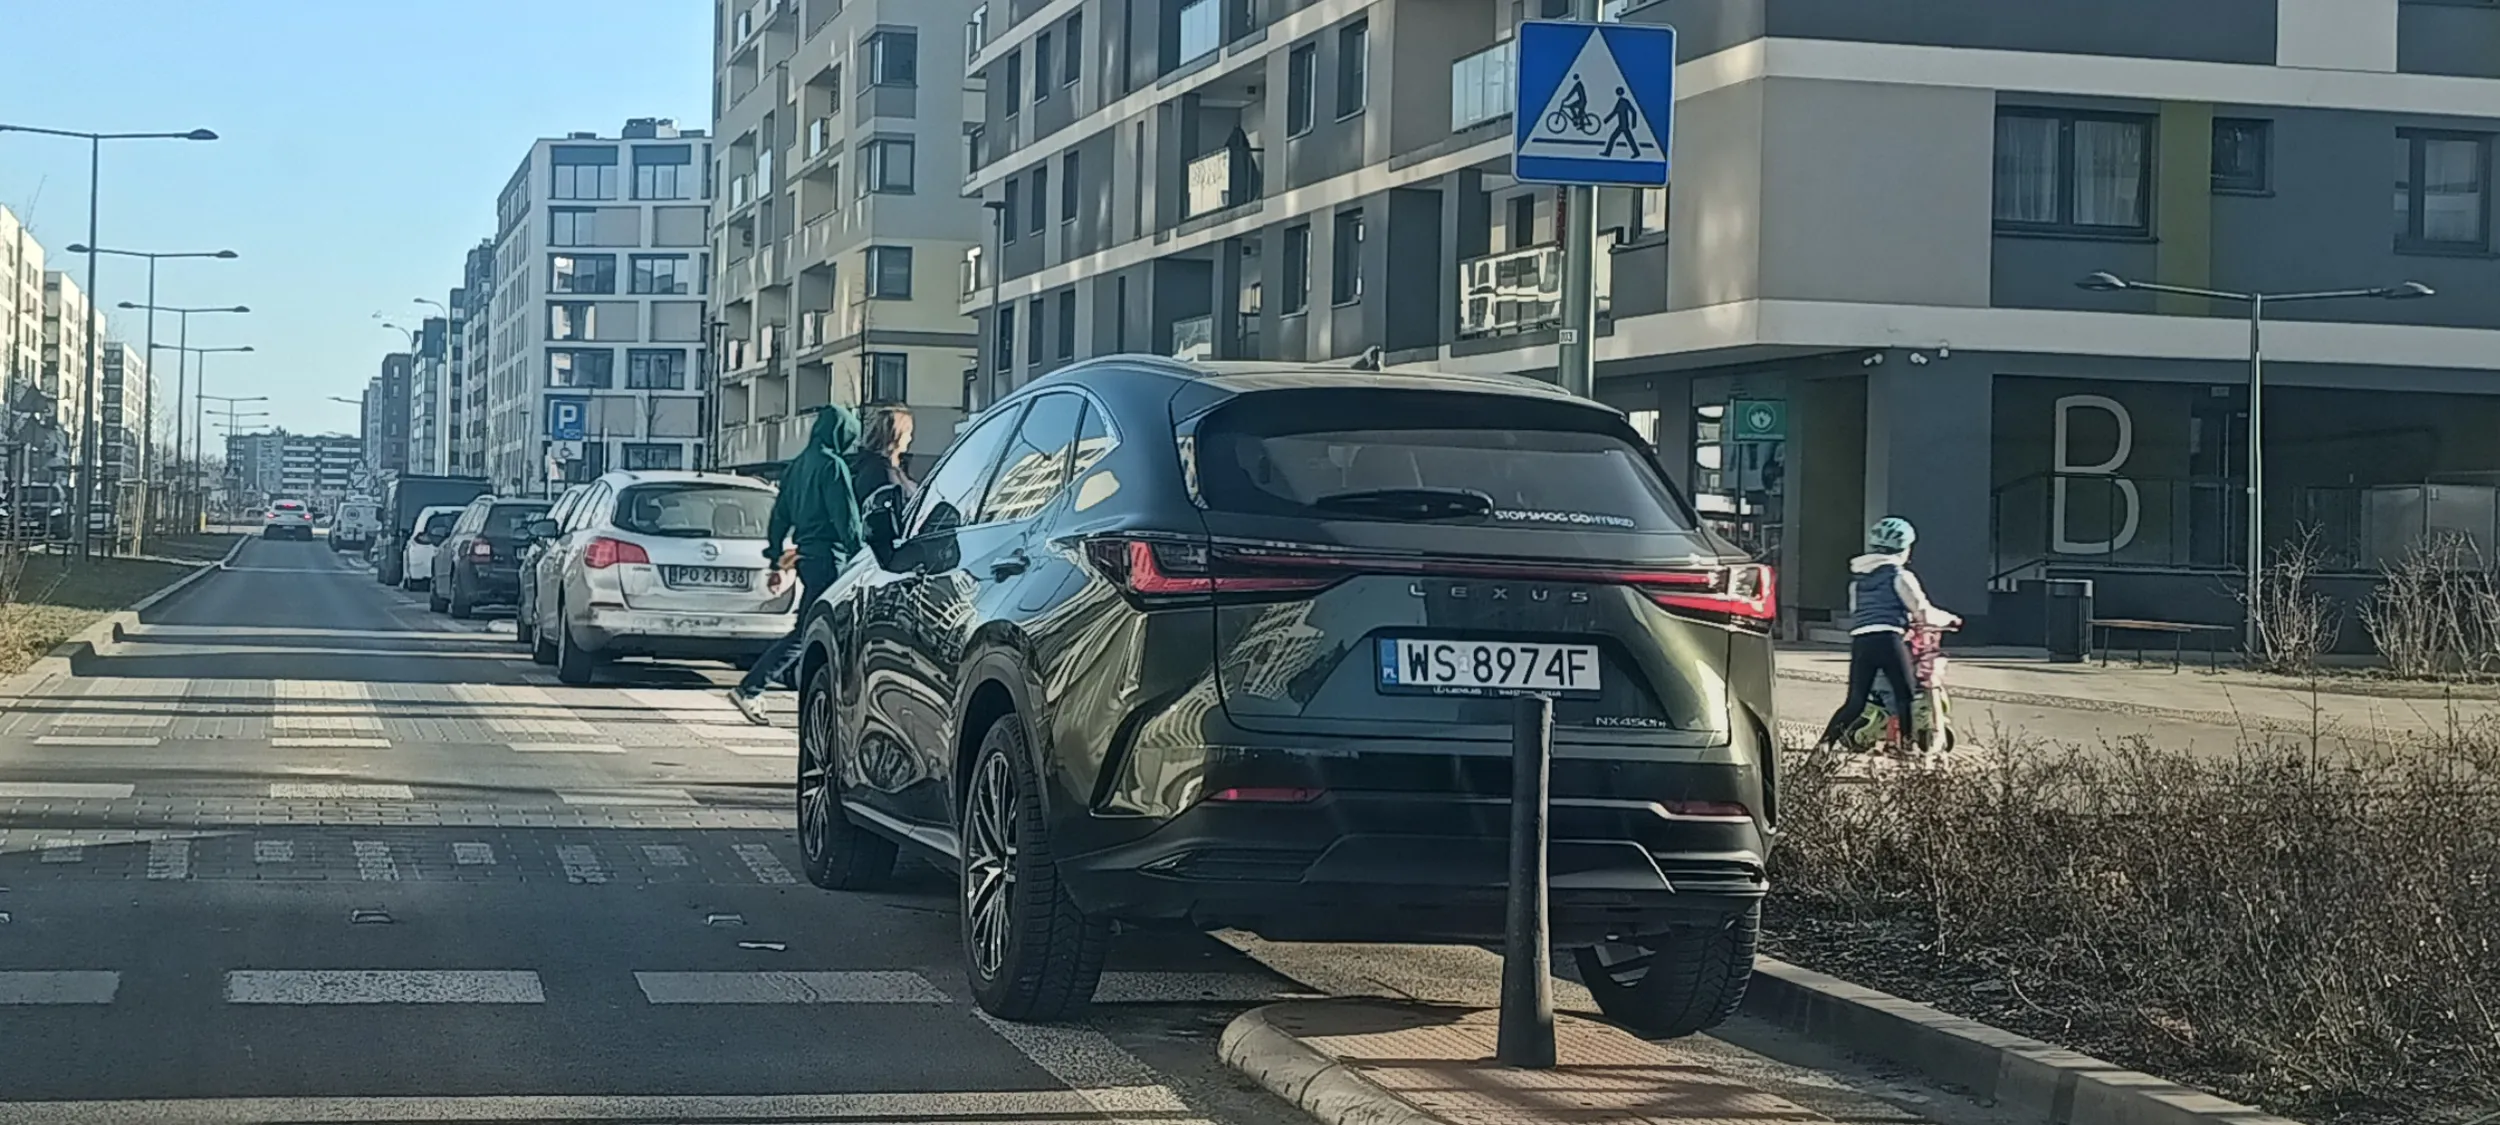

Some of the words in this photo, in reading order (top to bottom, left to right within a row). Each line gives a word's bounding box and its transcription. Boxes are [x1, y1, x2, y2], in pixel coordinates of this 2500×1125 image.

[558, 405, 577, 429] P
[2053, 394, 2140, 554] B
[679, 567, 700, 582] PO
[1409, 584, 1588, 603] LEXUS
[1383, 666, 1398, 680] PL
[1407, 643, 1457, 683] WS
[1472, 645, 1588, 687] 8974F
